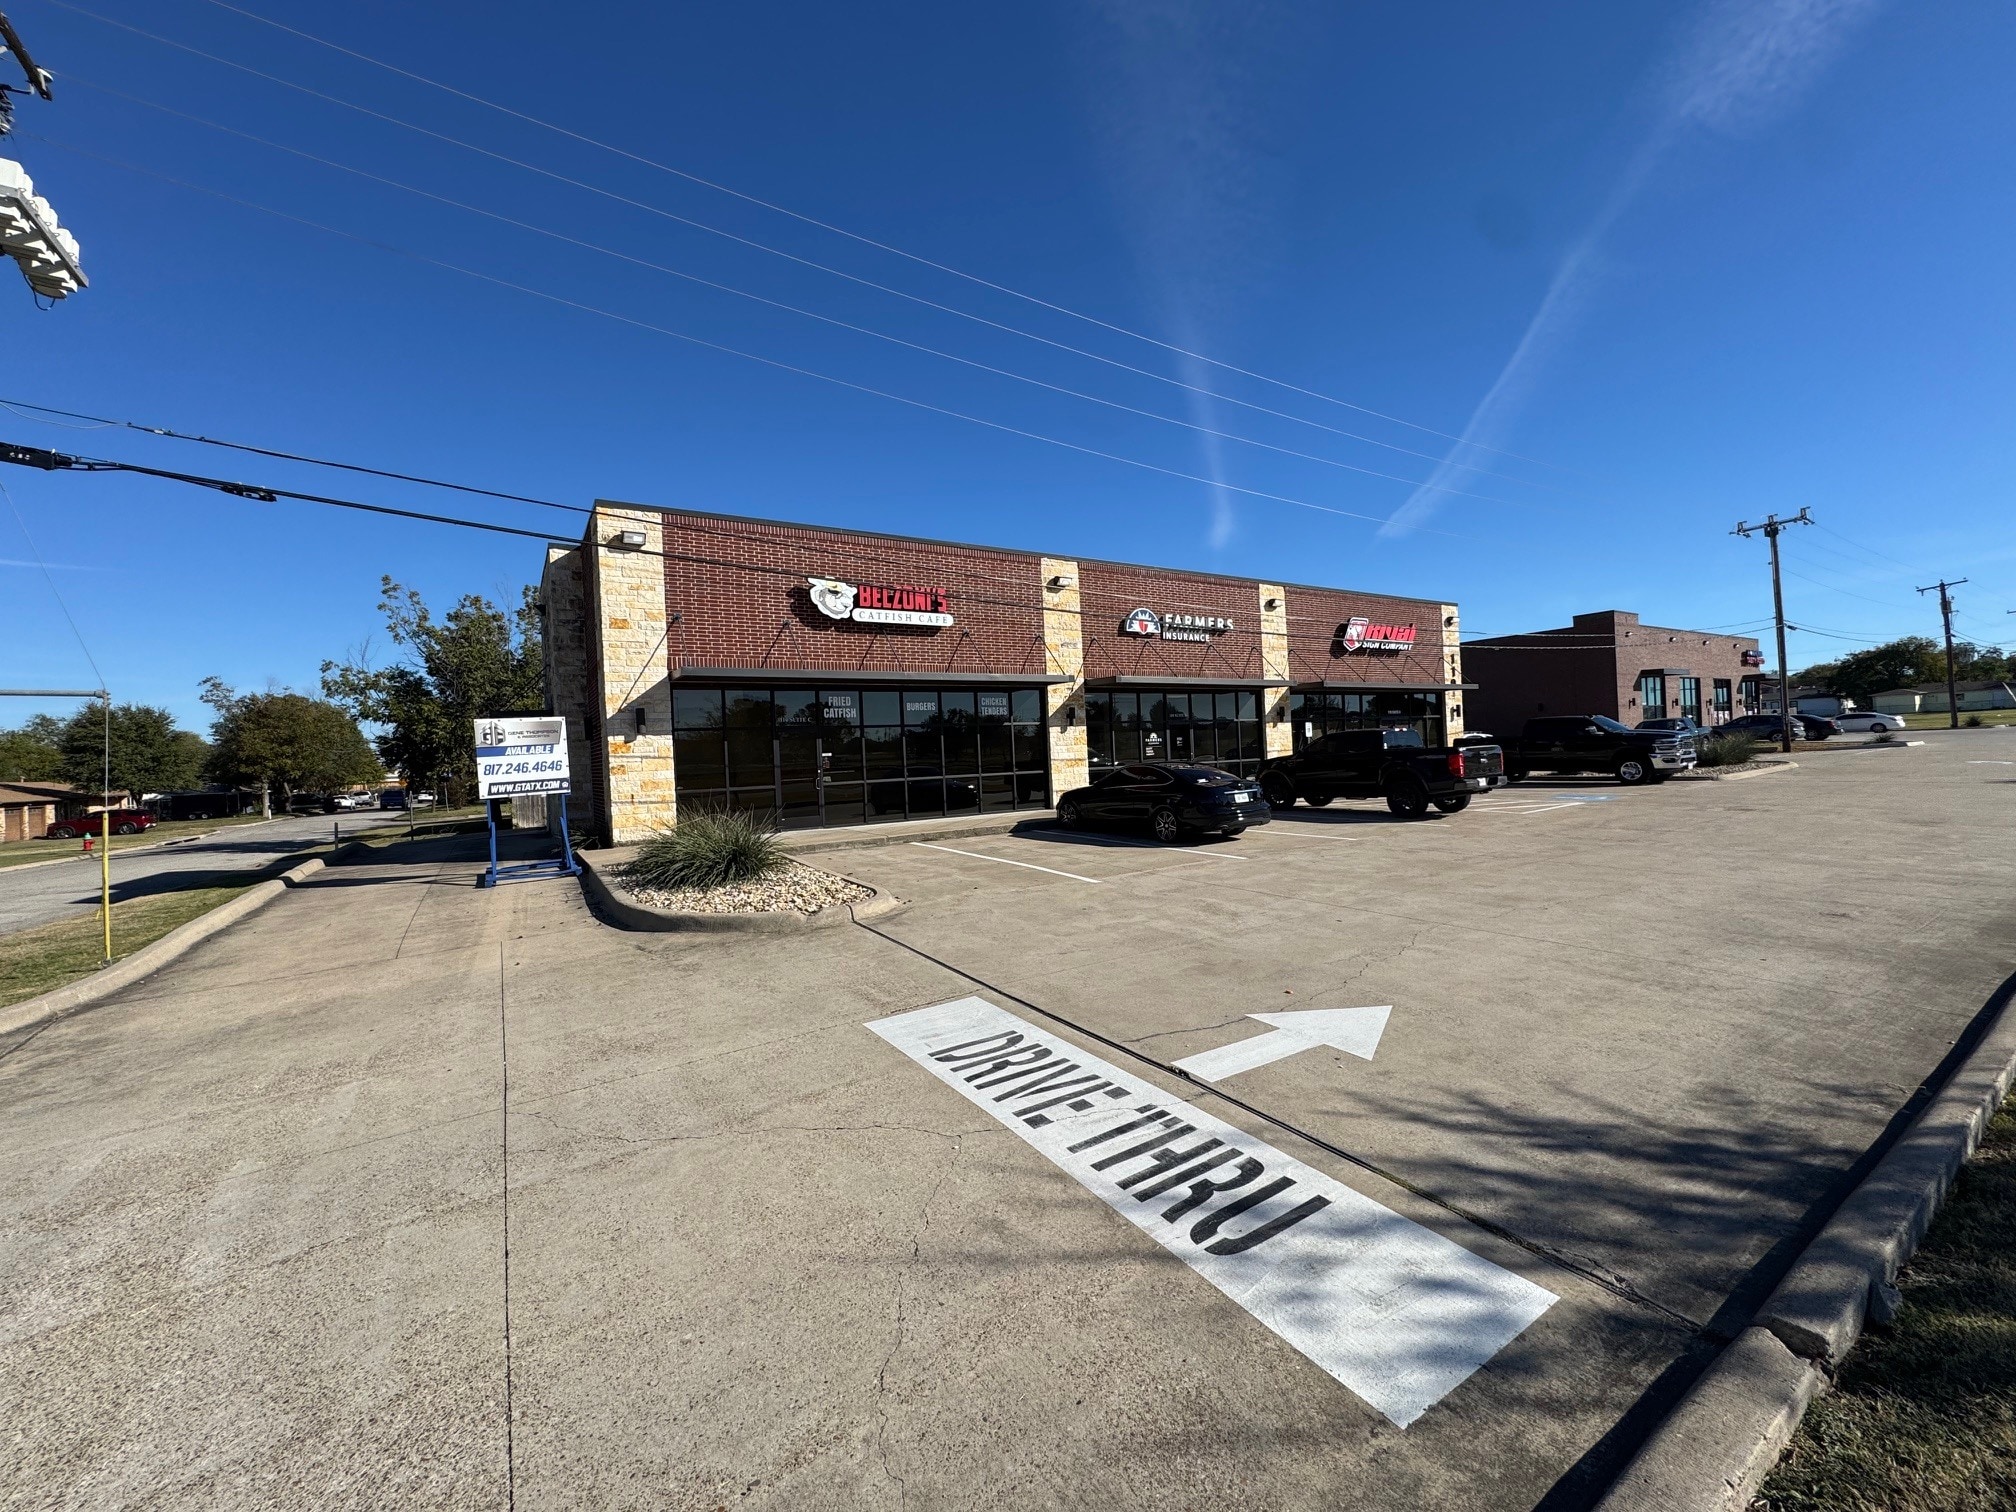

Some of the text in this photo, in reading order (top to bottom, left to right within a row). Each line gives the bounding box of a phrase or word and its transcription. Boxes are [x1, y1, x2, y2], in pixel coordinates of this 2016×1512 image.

[858, 610, 948, 624] CATFISH CAFE
[1165, 613, 1234, 630] FARMERS
[1162, 632, 1210, 642] INSURANCE
[828, 696, 851, 707] FRIED
[906, 702, 936, 711] BURGERS
[981, 697, 1007, 706] CHICKEN
[823, 707, 857, 719] CATFISH
[981, 706, 1008, 716] TENDERS
[505, 745, 551, 756] AVAILABLE
[483, 760, 563, 776] 817.246.4646
[490, 780, 560, 794] WWW.GTATX.COM
[1066, 1103, 1334, 1256] THRU
